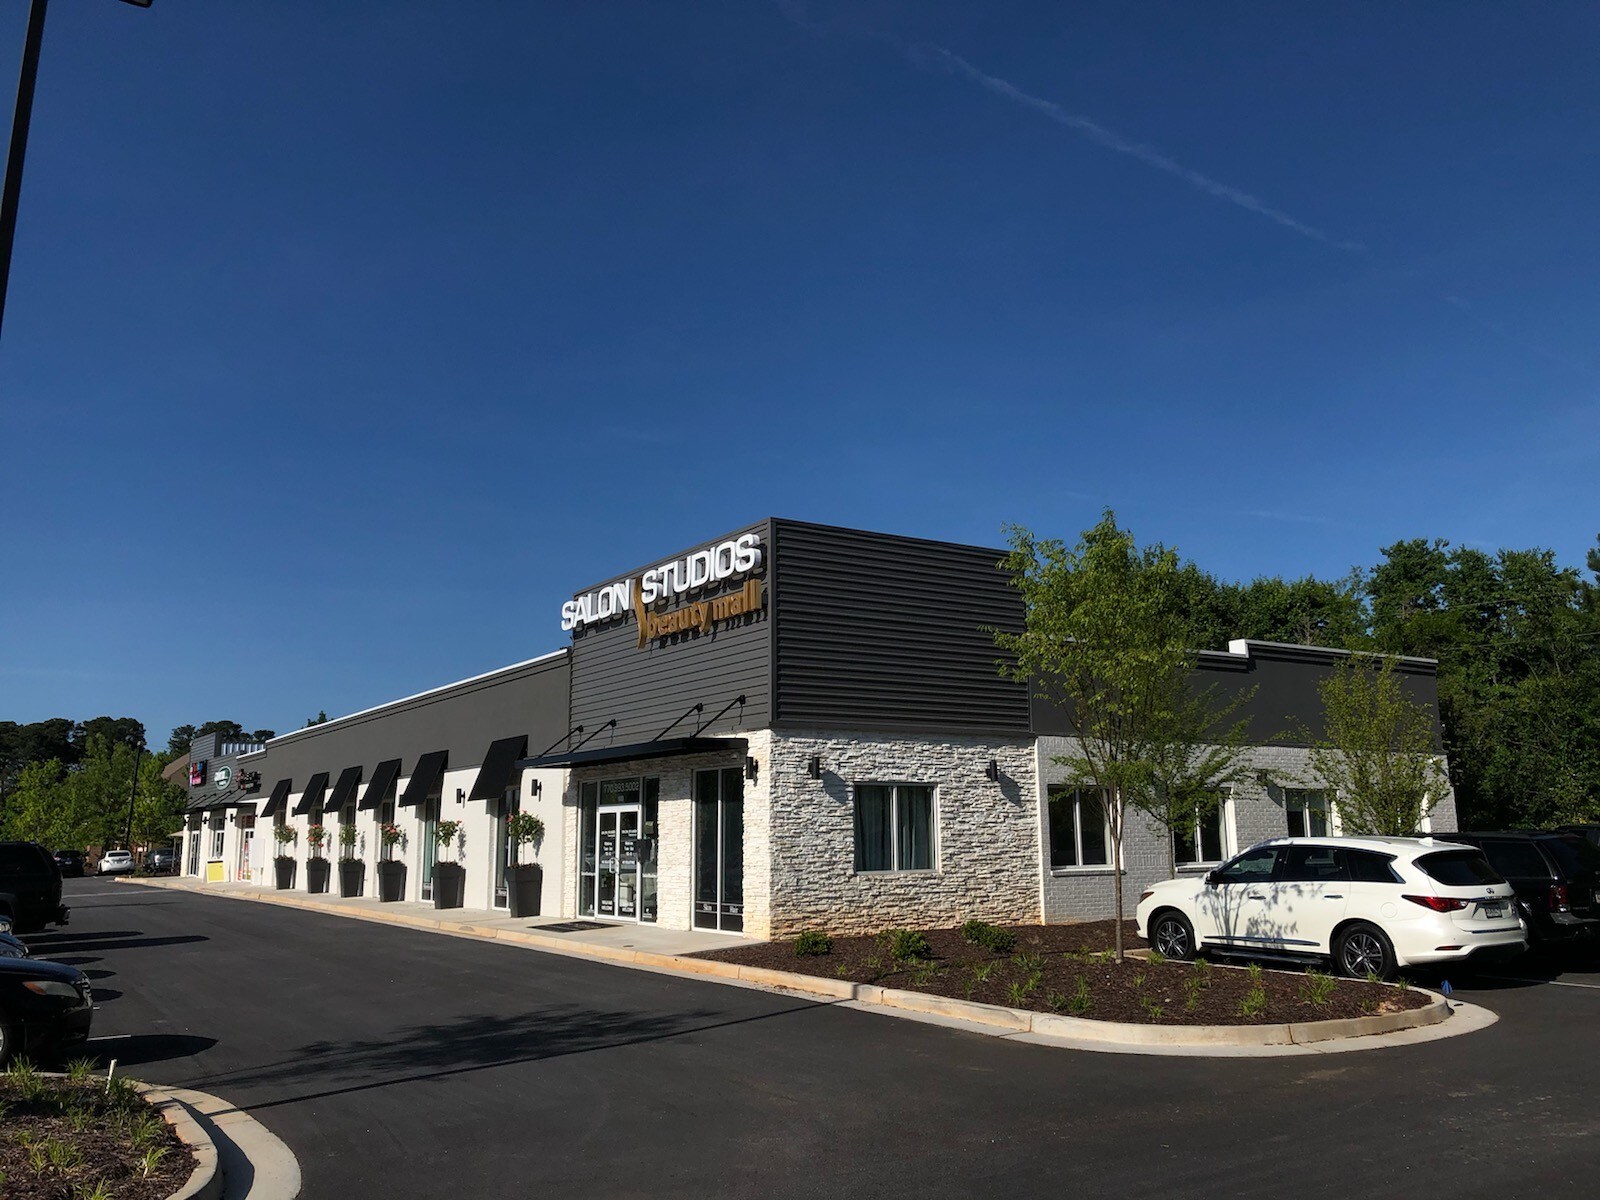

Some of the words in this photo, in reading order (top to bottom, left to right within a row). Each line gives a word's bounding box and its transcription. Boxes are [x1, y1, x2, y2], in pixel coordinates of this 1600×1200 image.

[561, 578, 633, 631] SALON
[641, 533, 762, 604] STUDIOS
[647, 601, 713, 639] beauty
[713, 578, 762, 621] mall
